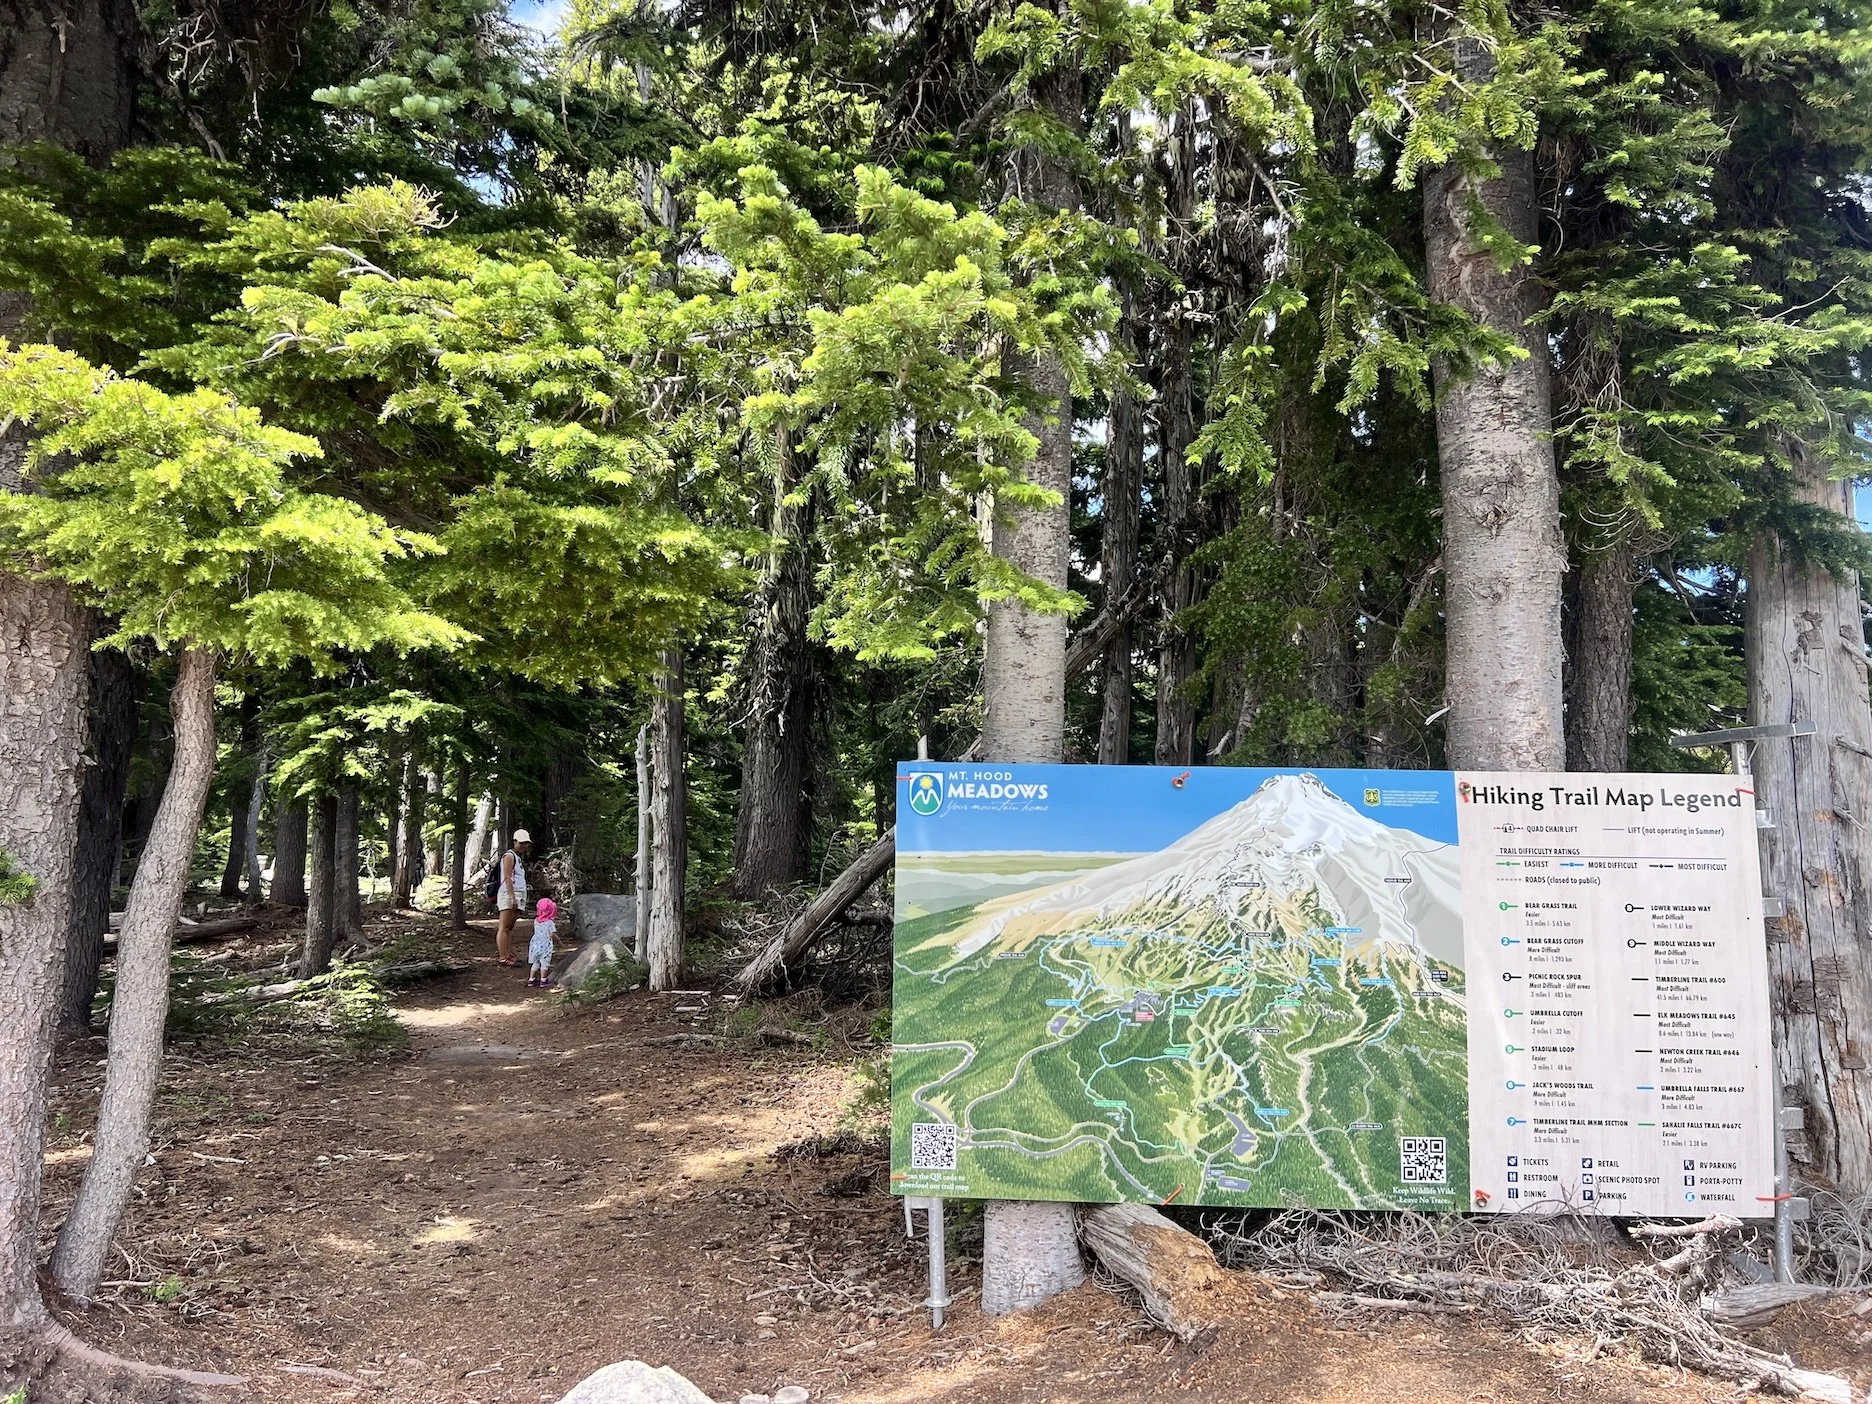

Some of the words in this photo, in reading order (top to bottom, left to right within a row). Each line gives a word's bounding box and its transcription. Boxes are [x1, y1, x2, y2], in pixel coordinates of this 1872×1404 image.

[948, 771, 968, 780] MT.
[974, 771, 1012, 780] HOOD
[947, 783, 1049, 800] MEADOWS
[1472, 786, 1544, 810] Hiking
[1550, 787, 1598, 806] Trail
[1605, 788, 1654, 812] Map
[1661, 788, 1741, 813] Legend
[971, 800, 1019, 812] mountain
[1021, 800, 1049, 812] home
[1526, 825, 1544, 833] QUAD
[1642, 826, 1656, 836] (not
[1657, 827, 1687, 836] operating
[1696, 827, 1725, 837] Summer)
[1547, 875, 1570, 886] (closed
[1579, 876, 1601, 886] public)
[1523, 1158, 1549, 1166] TICKETS
[1598, 1160, 1619, 1168] RETAIL
[919, 1172, 929, 1180] the
[930, 1172, 942, 1182] QR
[943, 1173, 958, 1181] code
[1523, 1174, 1559, 1182] RESTROOM
[1598, 1176, 1620, 1184] SCENIC
[1621, 1176, 1643, 1184] PHOTO
[1644, 1176, 1660, 1184] SPOT
[1700, 1177, 1743, 1185] PORTA-POTTY
[941, 1182, 954, 1190] trail
[1392, 1187, 1409, 1195] Keep
[1523, 1190, 1547, 1198] DINING
[1599, 1192, 1627, 1200] PARKING
